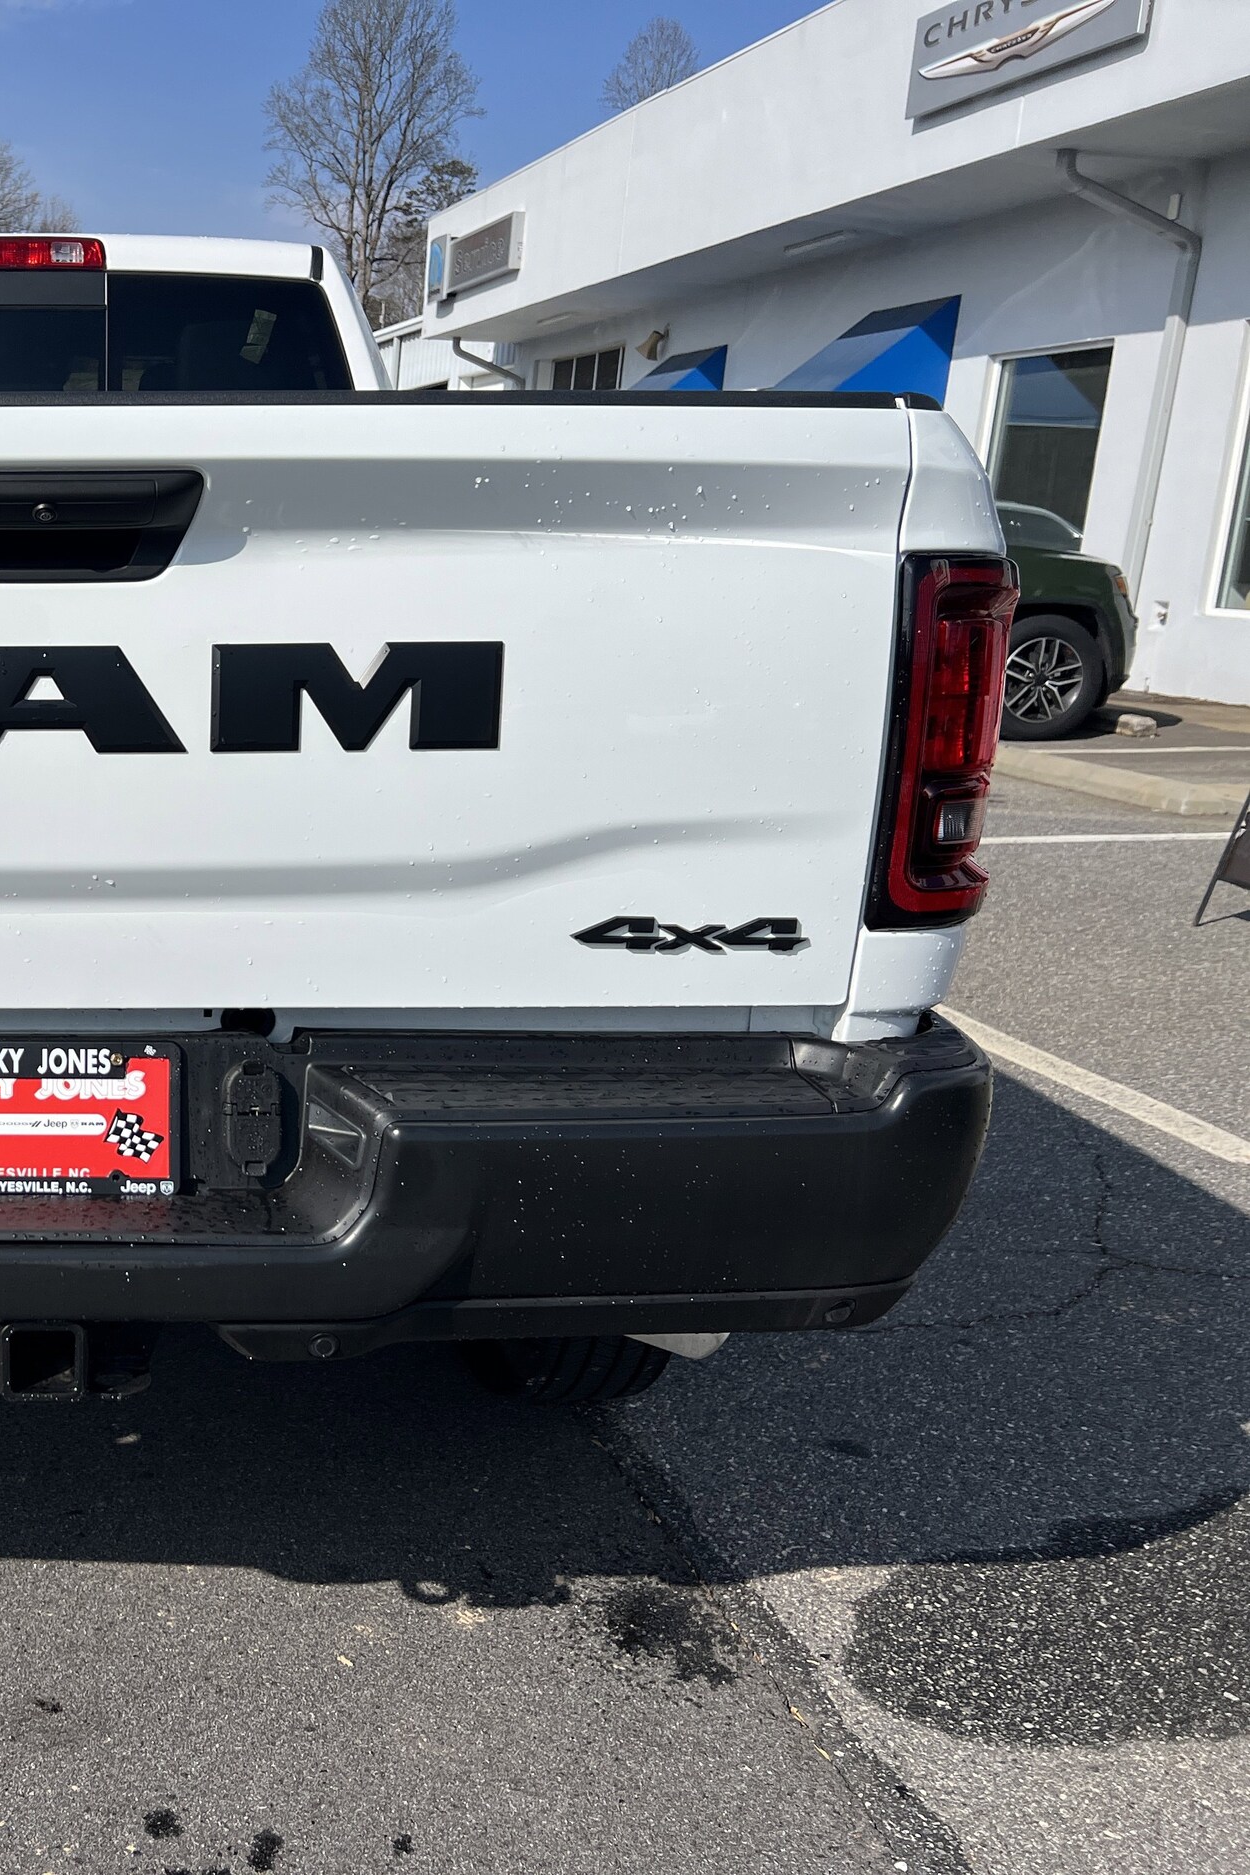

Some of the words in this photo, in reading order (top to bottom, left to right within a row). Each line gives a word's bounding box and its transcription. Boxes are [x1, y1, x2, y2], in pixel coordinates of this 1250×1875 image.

[569, 915, 812, 956] 4x4
[37, 1048, 111, 1075] JONES
[34, 1070, 146, 1100] JONES
[43, 1119, 68, 1128] Jeep
[66, 1181, 92, 1193] N.C.
[120, 1180, 157, 1195] Jeep
